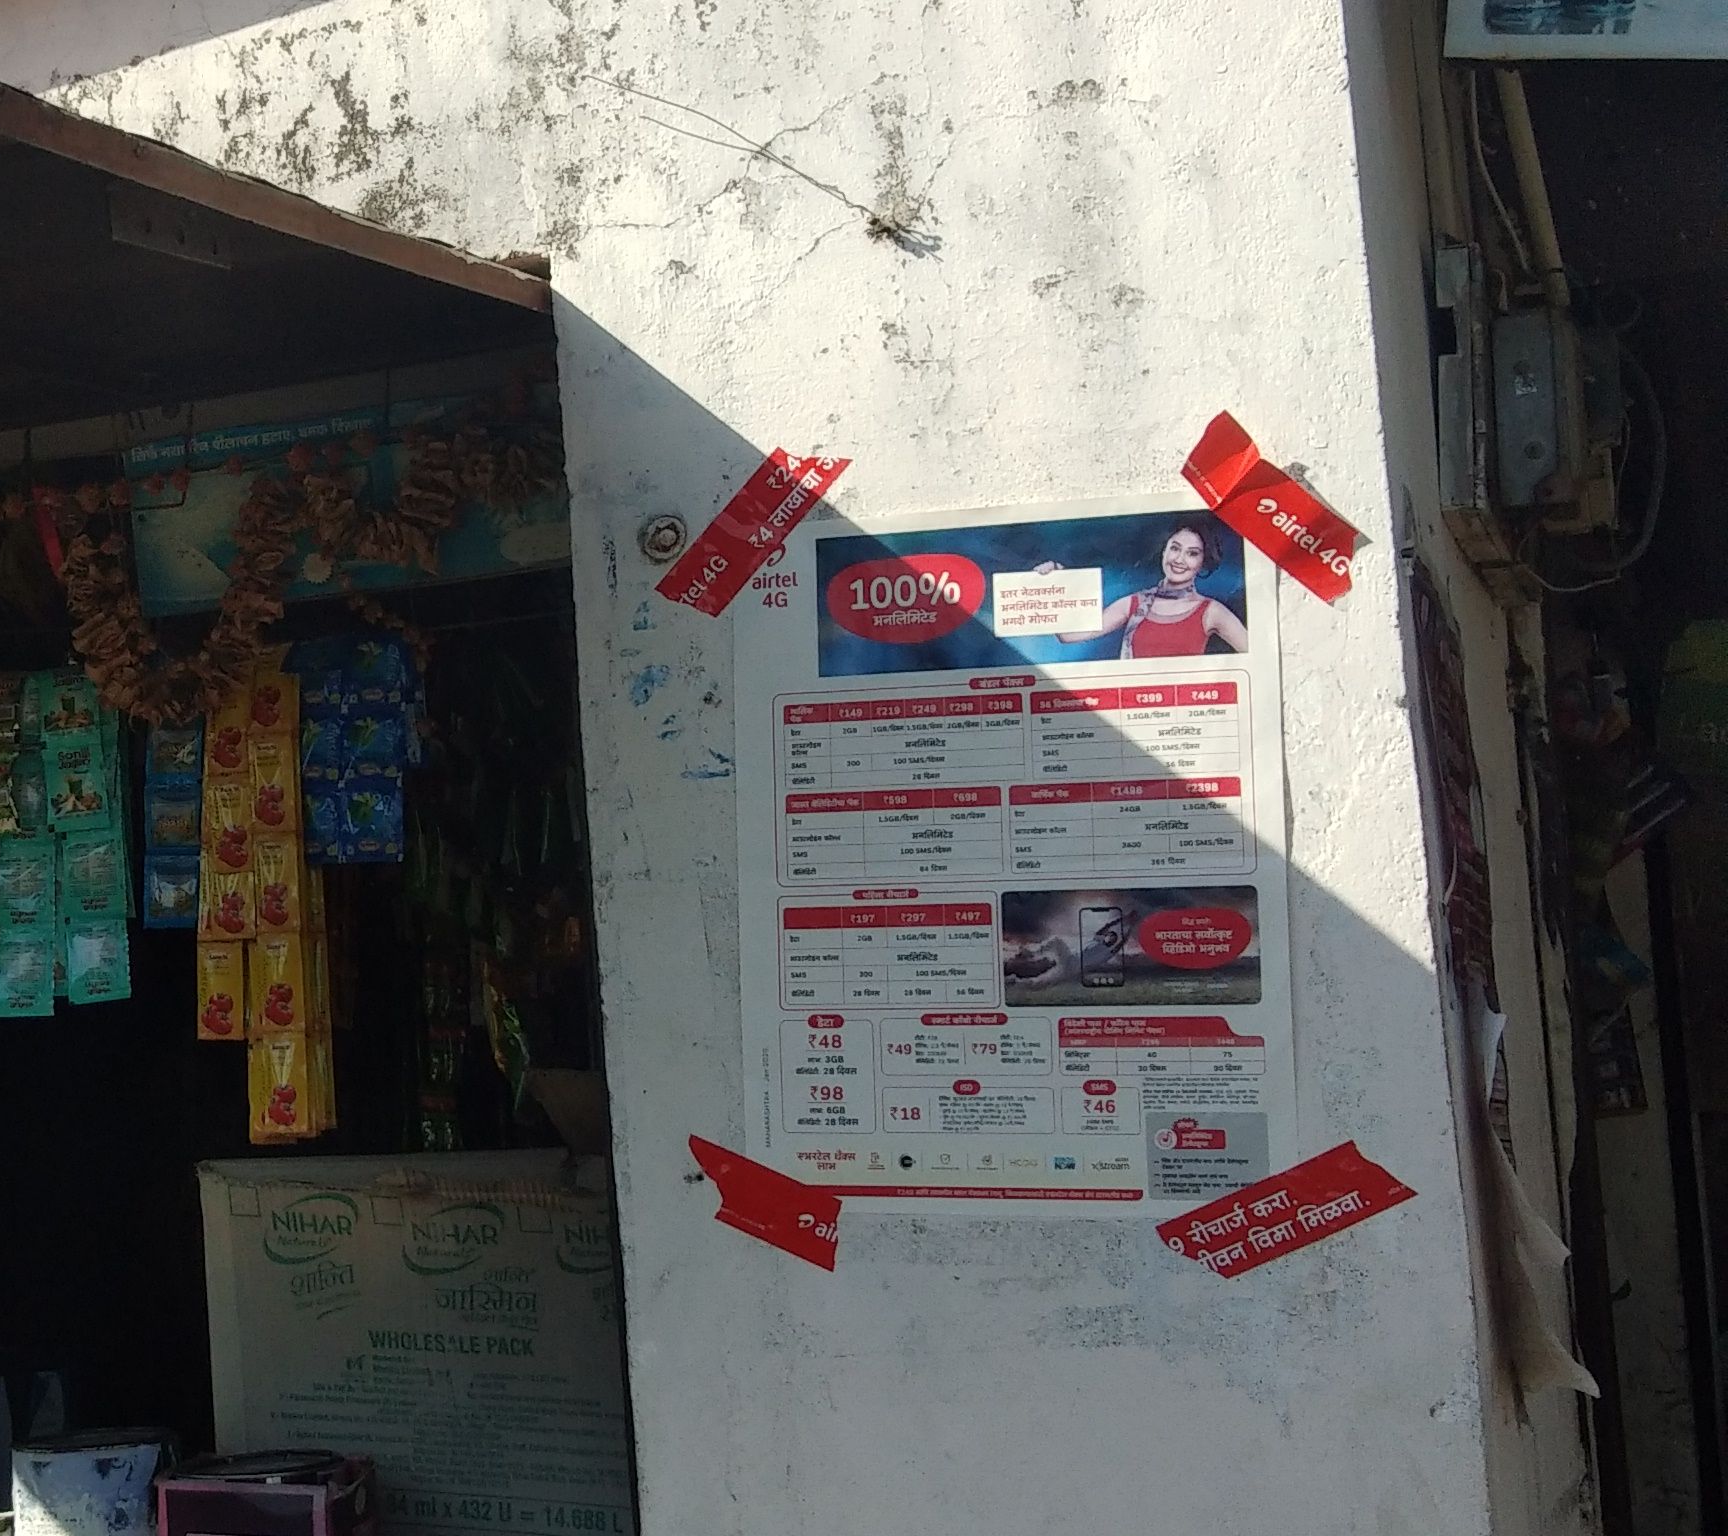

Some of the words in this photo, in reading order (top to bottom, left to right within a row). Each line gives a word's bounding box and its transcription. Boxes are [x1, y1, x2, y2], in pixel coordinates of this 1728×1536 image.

[748, 526, 773, 548] ₹4
[1272, 509, 1325, 556] airtel
[1318, 547, 1350, 577] 4G
[702, 555, 729, 582] 4G
[752, 571, 798, 589] airtel
[849, 571, 961, 610] 100%
[762, 592, 788, 608] 4G
[873, 609, 937, 627] अनलिमिटेड
[1136, 693, 1163, 703] ₹399
[1191, 690, 1219, 700] ₹449
[839, 708, 863, 718] ₹149
[876, 706, 901, 716] ₹219
[912, 704, 937, 714] ₹249
[1186, 782, 1219, 793] ₹2398
[850, 914, 875, 924] ₹197
[900, 913, 926, 922] ₹297
[955, 911, 981, 921] ₹497
[808, 1034, 842, 1048] ₹48
[887, 1043, 912, 1055] ₹49
[972, 1043, 997, 1055] ₹79
[836, 1064, 857, 1075] दिवस
[810, 1086, 844, 1100] ₹98
[890, 1106, 921, 1120] ₹18
[1083, 1099, 1116, 1113] ₹46
[837, 1116, 859, 1126] दिवस
[272, 1210, 353, 1237] NIHAR
[1187, 1202, 1247, 1244] रीचार्ज
[1248, 1190, 1299, 1219] करा.
[1247, 1220, 1298, 1253] विमा
[1297, 1190, 1371, 1234] मिळवा.
[411, 1221, 499, 1246] NIHAR
[563, 1221, 610, 1244] NIH
[368, 1330, 482, 1355] WHOLESALE
[486, 1335, 535, 1357] PACK
[458, 1498, 494, 1522] 432
